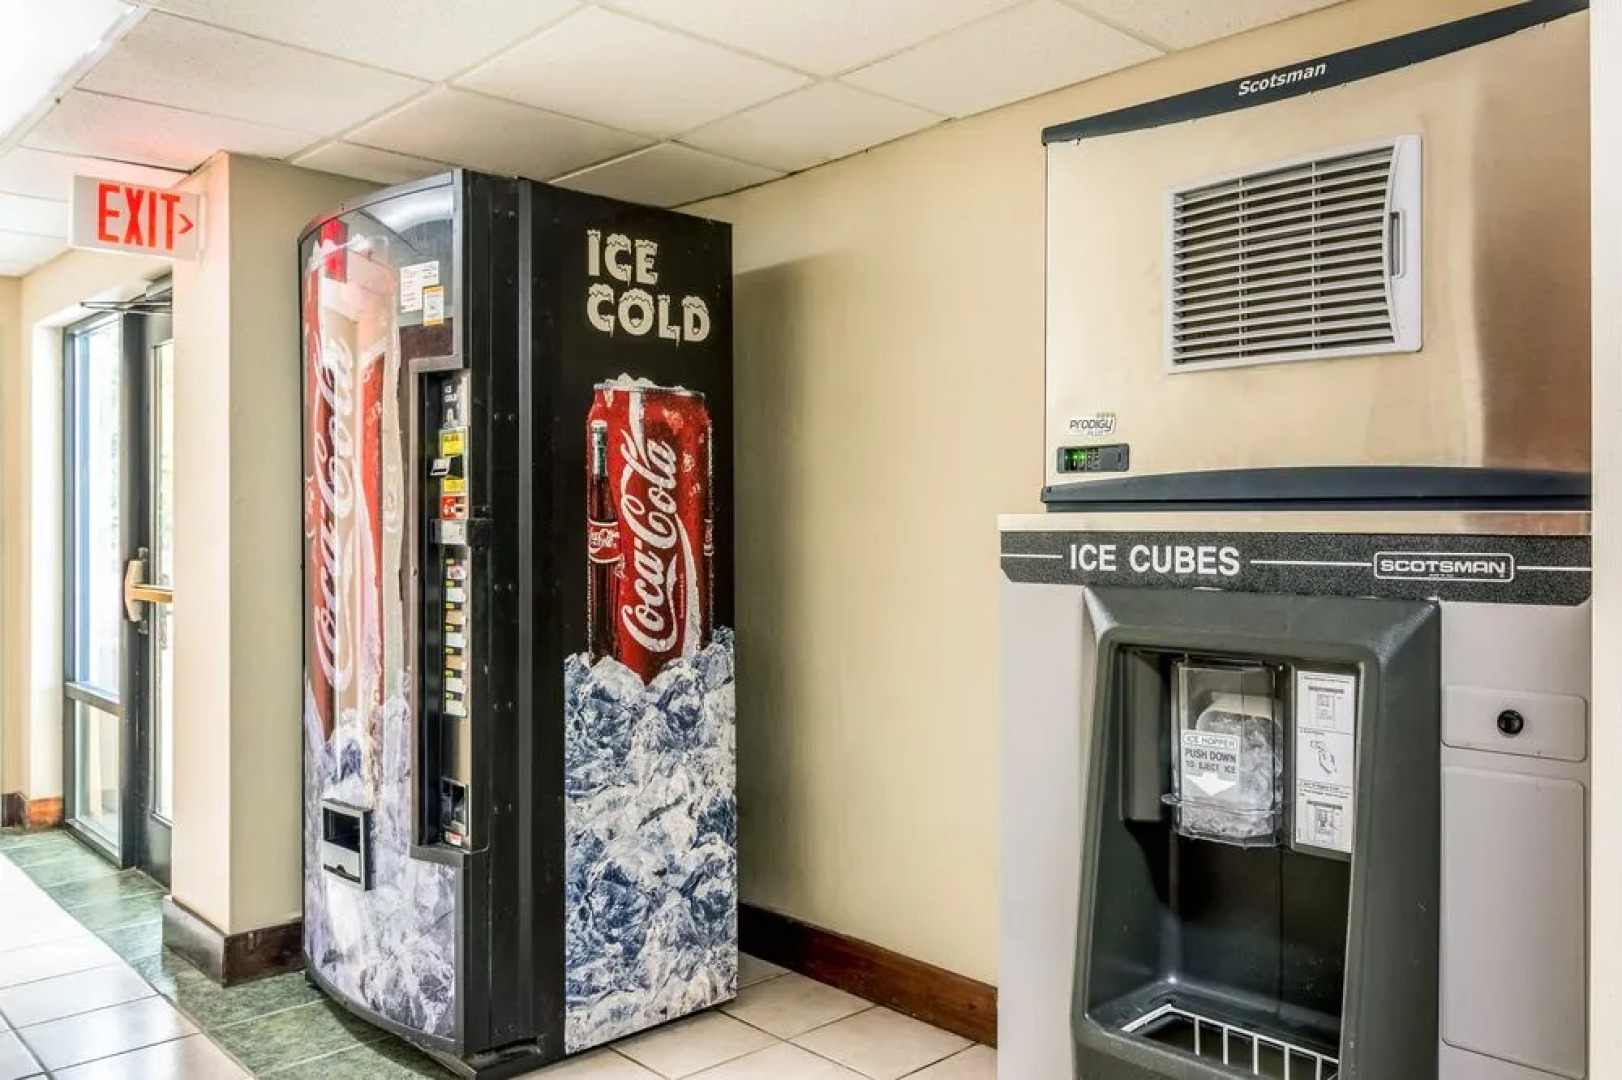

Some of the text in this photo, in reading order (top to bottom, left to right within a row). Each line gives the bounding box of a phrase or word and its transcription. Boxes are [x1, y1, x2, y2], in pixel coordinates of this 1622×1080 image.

[1238, 62, 1327, 96] Scotsman
[97, 181, 181, 250] EXIT
[586, 229, 659, 287] ICE
[586, 283, 711, 348] COLD
[620, 434, 678, 653] Coca-Cola
[1070, 544, 1240, 576] ICE CUBES
[1380, 559, 1506, 574] SCOTSMAN
[1185, 748, 1237, 764] PUSH DOWN
[1224, 765, 1237, 774] ICE
